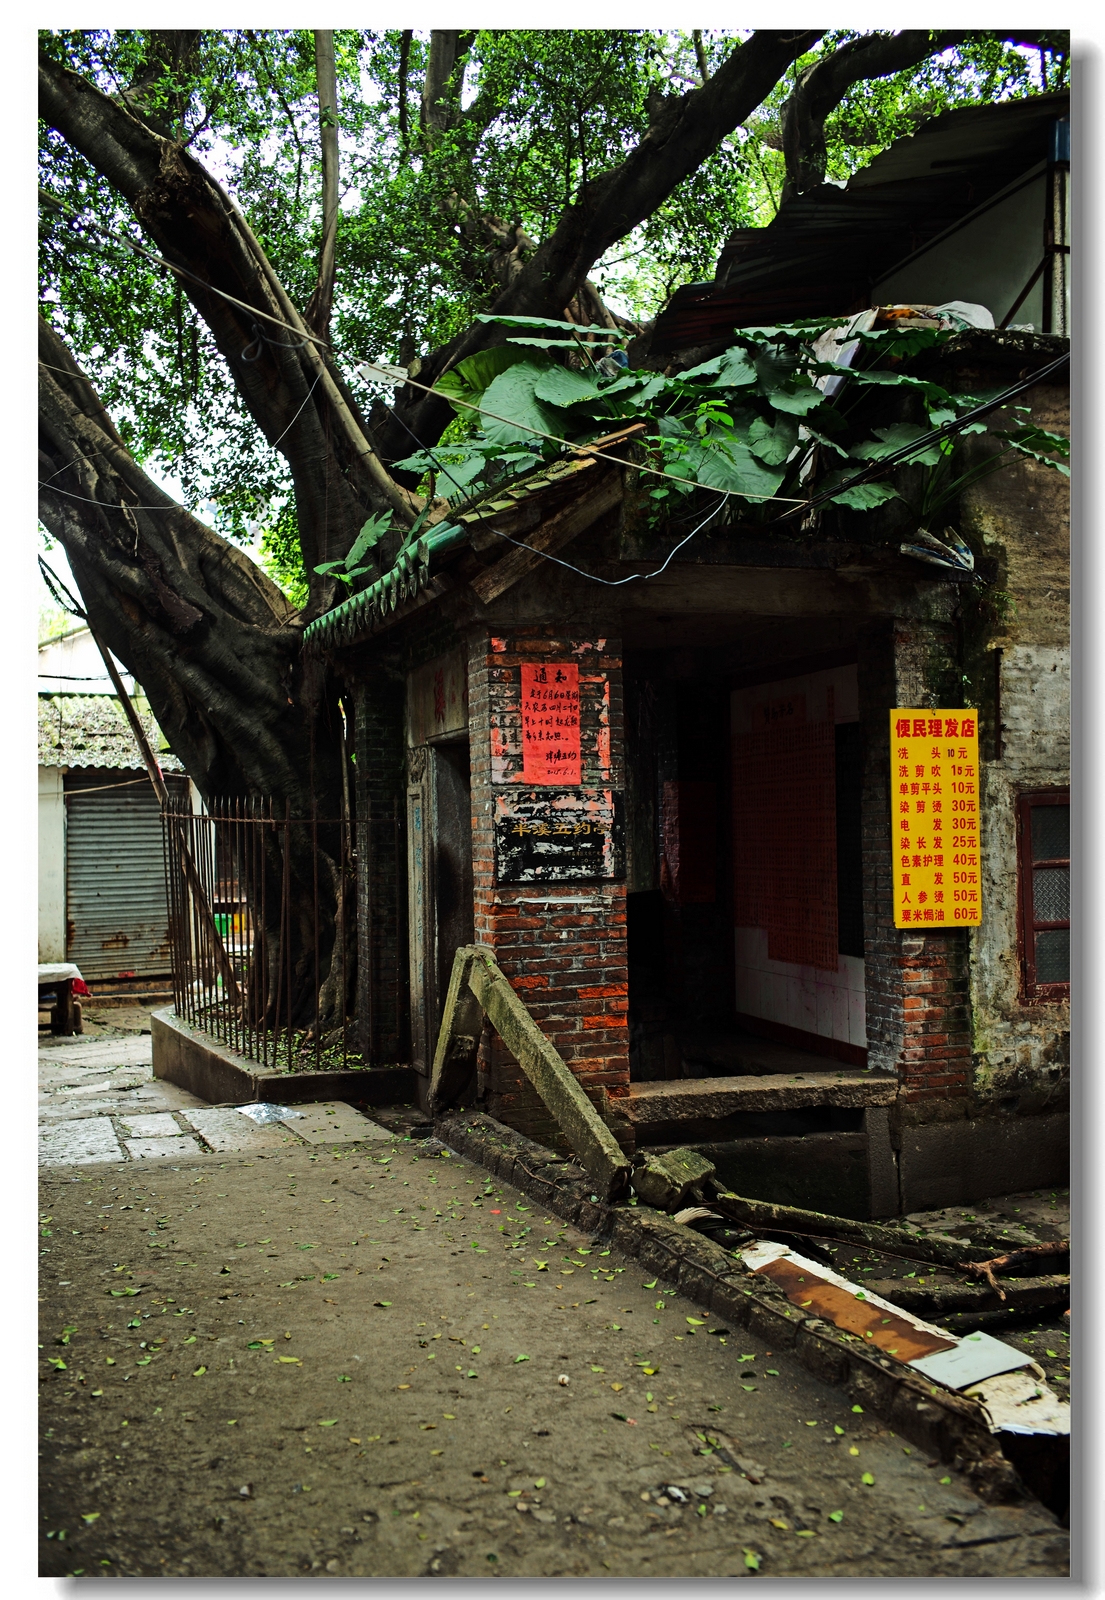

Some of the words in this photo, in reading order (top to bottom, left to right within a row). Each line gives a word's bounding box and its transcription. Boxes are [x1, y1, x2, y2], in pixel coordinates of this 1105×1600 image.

[533, 667, 567, 684] 通知
[895, 718, 975, 738] 便民理发店
[899, 765, 941, 777] 洗剪吹
[951, 765, 974, 777] 15元
[899, 782, 942, 795] 单剪平头
[952, 782, 975, 794] 10元
[900, 800, 942, 813] 染剪烫
[952, 800, 976, 812] 30元
[952, 818, 976, 830] 30元
[900, 836, 942, 850] 染长发
[952, 836, 977, 848] 25元
[901, 854, 944, 868] 色素护理
[953, 854, 977, 866] 40元
[953, 872, 977, 884] 50元
[902, 890, 944, 904] 人参烫
[954, 890, 978, 902] 50元
[954, 908, 978, 920] 60元
